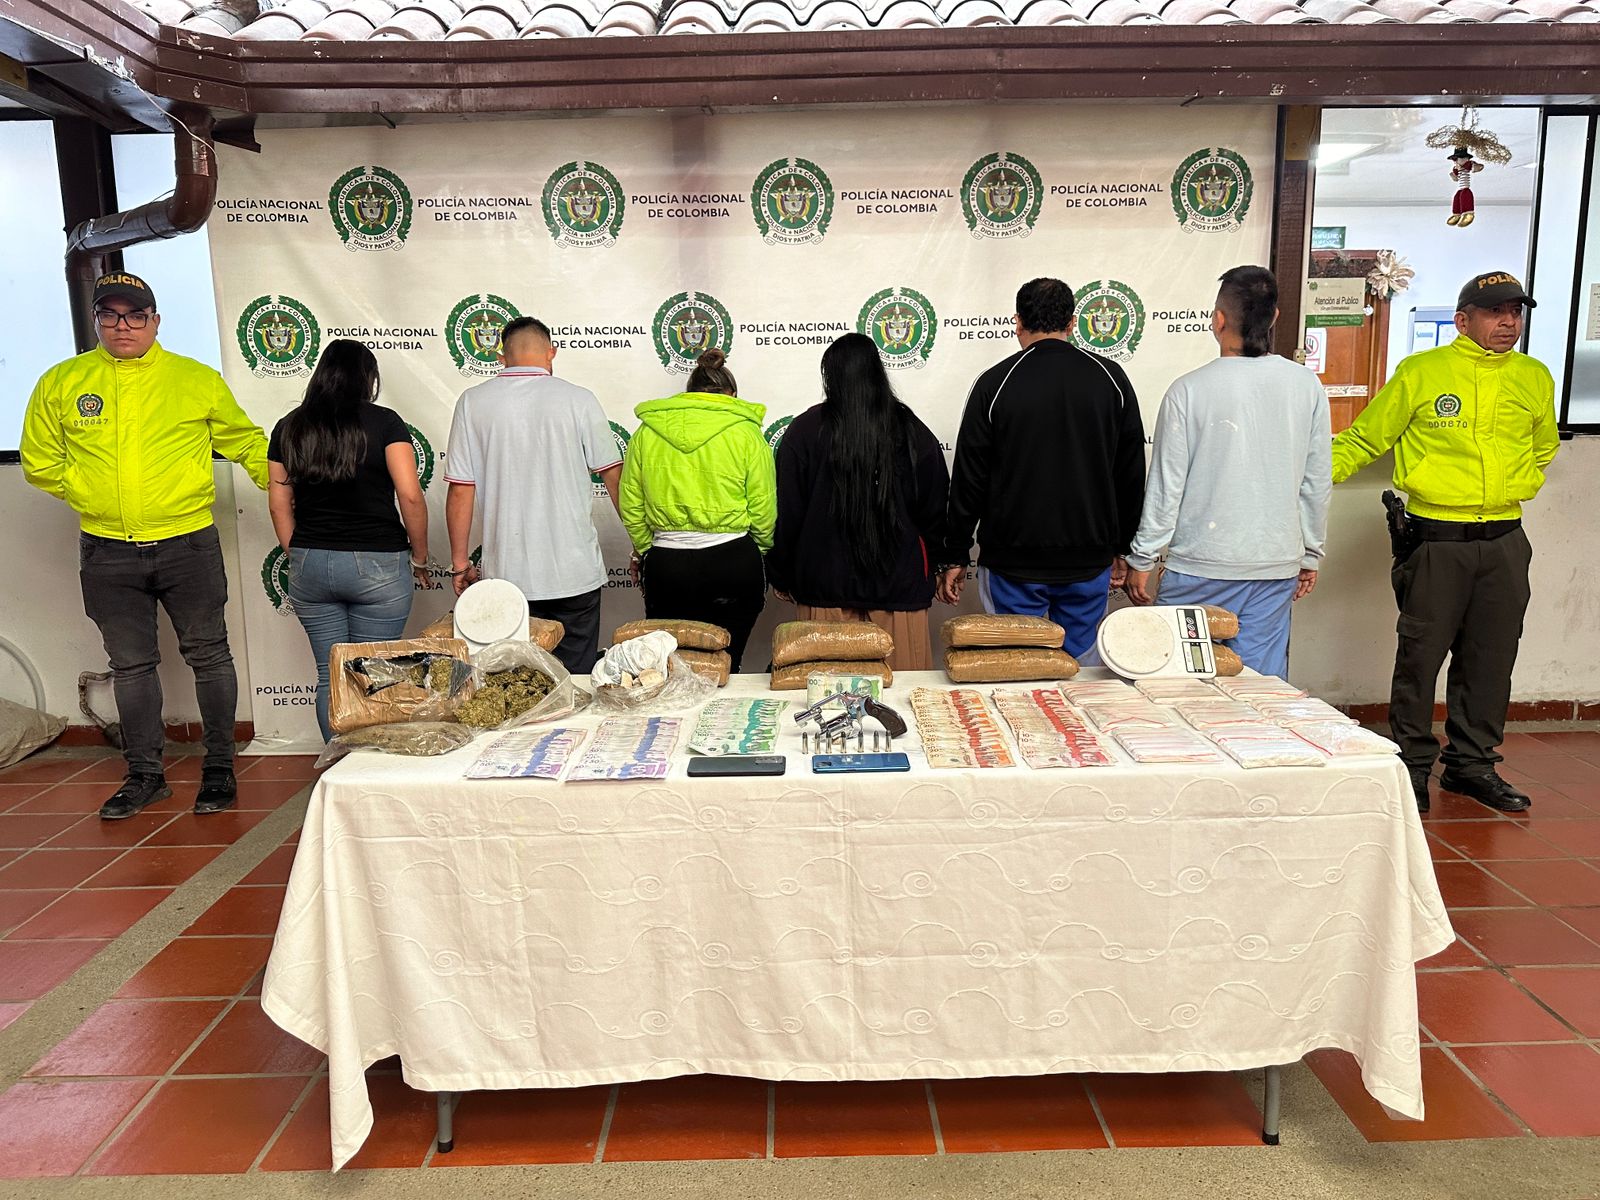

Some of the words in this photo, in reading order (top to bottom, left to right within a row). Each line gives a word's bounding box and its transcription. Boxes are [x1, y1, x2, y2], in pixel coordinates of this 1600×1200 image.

[971, 166, 992, 201] REPUBLICA
[1014, 166, 1033, 200] COLOMBIA
[1182, 161, 1203, 196] REPUBLICA
[1226, 161, 1243, 195] COLOMBIA
[552, 175, 571, 210] REPUBLICA
[594, 175, 615, 209] COLOMBIA
[762, 171, 782, 207] REPUBLICA
[804, 172, 824, 205] COLOMBIA
[1051, 182, 1097, 194] POLICÍA
[1101, 184, 1163, 193] NACIONAL
[339, 180, 359, 213] REPUBLICA
[382, 179, 402, 212] COLOMBIA
[632, 193, 679, 204] POLICÍA
[682, 194, 745, 203] NACIONAL
[841, 189, 888, 200] POLICÍA
[891, 189, 954, 199] NACIONAL
[214, 198, 257, 208] OLICÍA
[259, 200, 323, 209] NACIONAL
[418, 196, 466, 207] POLICÍA
[469, 197, 532, 207] NACIONAL
[1066, 199, 1081, 208] DE
[1085, 198, 1147, 207] COLOMBIA
[648, 209, 663, 217] DE
[667, 208, 730, 217] COLOMBIA
[857, 205, 872, 214] DE
[875, 204, 937, 213] COLOMBIA
[1185, 204, 1205, 221] POLICIA
[1213, 202, 1239, 222] NACIONAL
[227, 214, 242, 222] DE
[246, 213, 309, 223] COLOMBIA
[435, 212, 450, 221] DE
[454, 211, 517, 221] COLOMBIA
[974, 209, 994, 227] POLICIA
[1002, 208, 1029, 228] NACIONAL
[556, 217, 578, 236] POLICIA
[586, 218, 612, 238] NACIONAL
[766, 214, 786, 234] POLICIA
[794, 214, 820, 234] NACIONAL
[1212, 221, 1231, 230] PATRIA
[345, 222, 367, 240] POLICIA
[374, 221, 400, 241] NACIONAL
[1001, 227, 1022, 236] PATRIA
[586, 236, 606, 246] PATRIA
[794, 233, 814, 242] PATRIA
[375, 239, 395, 249] PATRIA
[97, 275, 144, 290] POLICIA
[1075, 293, 1094, 314] UBLICA
[1117, 293, 1135, 324] COLOMBIA
[867, 300, 887, 334] REPUBLICA
[909, 300, 927, 332] COLOMBIA
[1153, 309, 1196, 320] POLICÍA
[248, 308, 265, 341] REPUBLICA
[288, 308, 310, 341] COLOMBIA
[456, 307, 474, 341] REPUBLICA
[663, 305, 681, 338] REPUBLICA
[704, 305, 723, 337] COLOMBIA
[944, 315, 990, 327] POLICÍA
[327, 325, 370, 336] POLICÍA
[374, 328, 438, 336] NACIONAL
[552, 325, 581, 335] LICÍA
[585, 326, 646, 335] NACIONAL
[740, 321, 785, 333] POLICÍA
[789, 322, 850, 332] NACIONAL
[1168, 325, 1181, 333] DE
[756, 337, 770, 345] DE
[774, 336, 834, 345] COLOMBIA
[960, 331, 974, 339] DE
[552, 340, 566, 348] DE
[570, 340, 631, 348] COLOMBIA
[1076, 335, 1096, 352] POLICIA
[1103, 334, 1131, 353] NACIONAL
[667, 346, 687, 364] POLICIA
[898, 340, 924, 359] NACIONAL
[253, 350, 274, 367] POLICIA
[281, 348, 308, 368] NACIONAL
[461, 348, 482, 366] POLICIA
[897, 358, 918, 367] PATRIA
[281, 366, 302, 376] PATRIA
[273, 552, 287, 582] REPUBLIC
[256, 684, 302, 695] POLICÍA
[273, 698, 288, 706] DE
